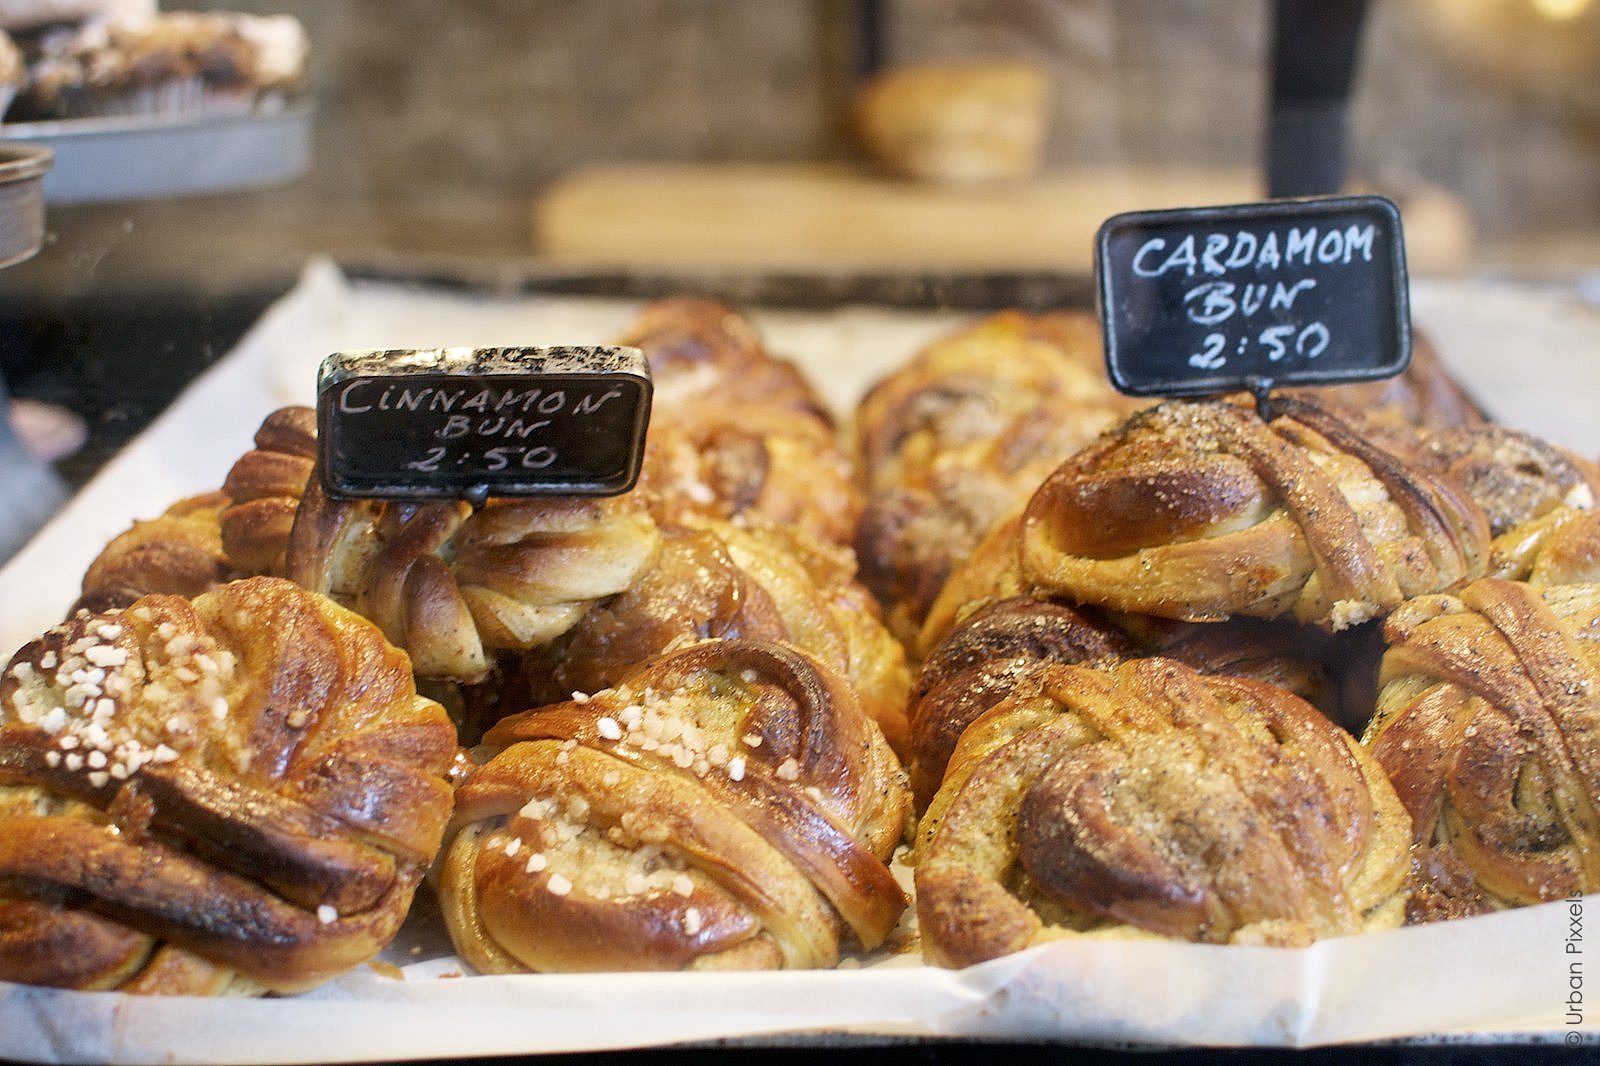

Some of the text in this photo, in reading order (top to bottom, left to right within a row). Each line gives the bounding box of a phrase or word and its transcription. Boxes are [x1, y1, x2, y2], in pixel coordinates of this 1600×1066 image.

[1132, 224, 1376, 277] CARDAMOM
[1183, 278, 1317, 325] BUN
[1188, 321, 1331, 369] 2:50
[434, 414, 552, 440] BUN
[407, 446, 558, 472] 2:50
